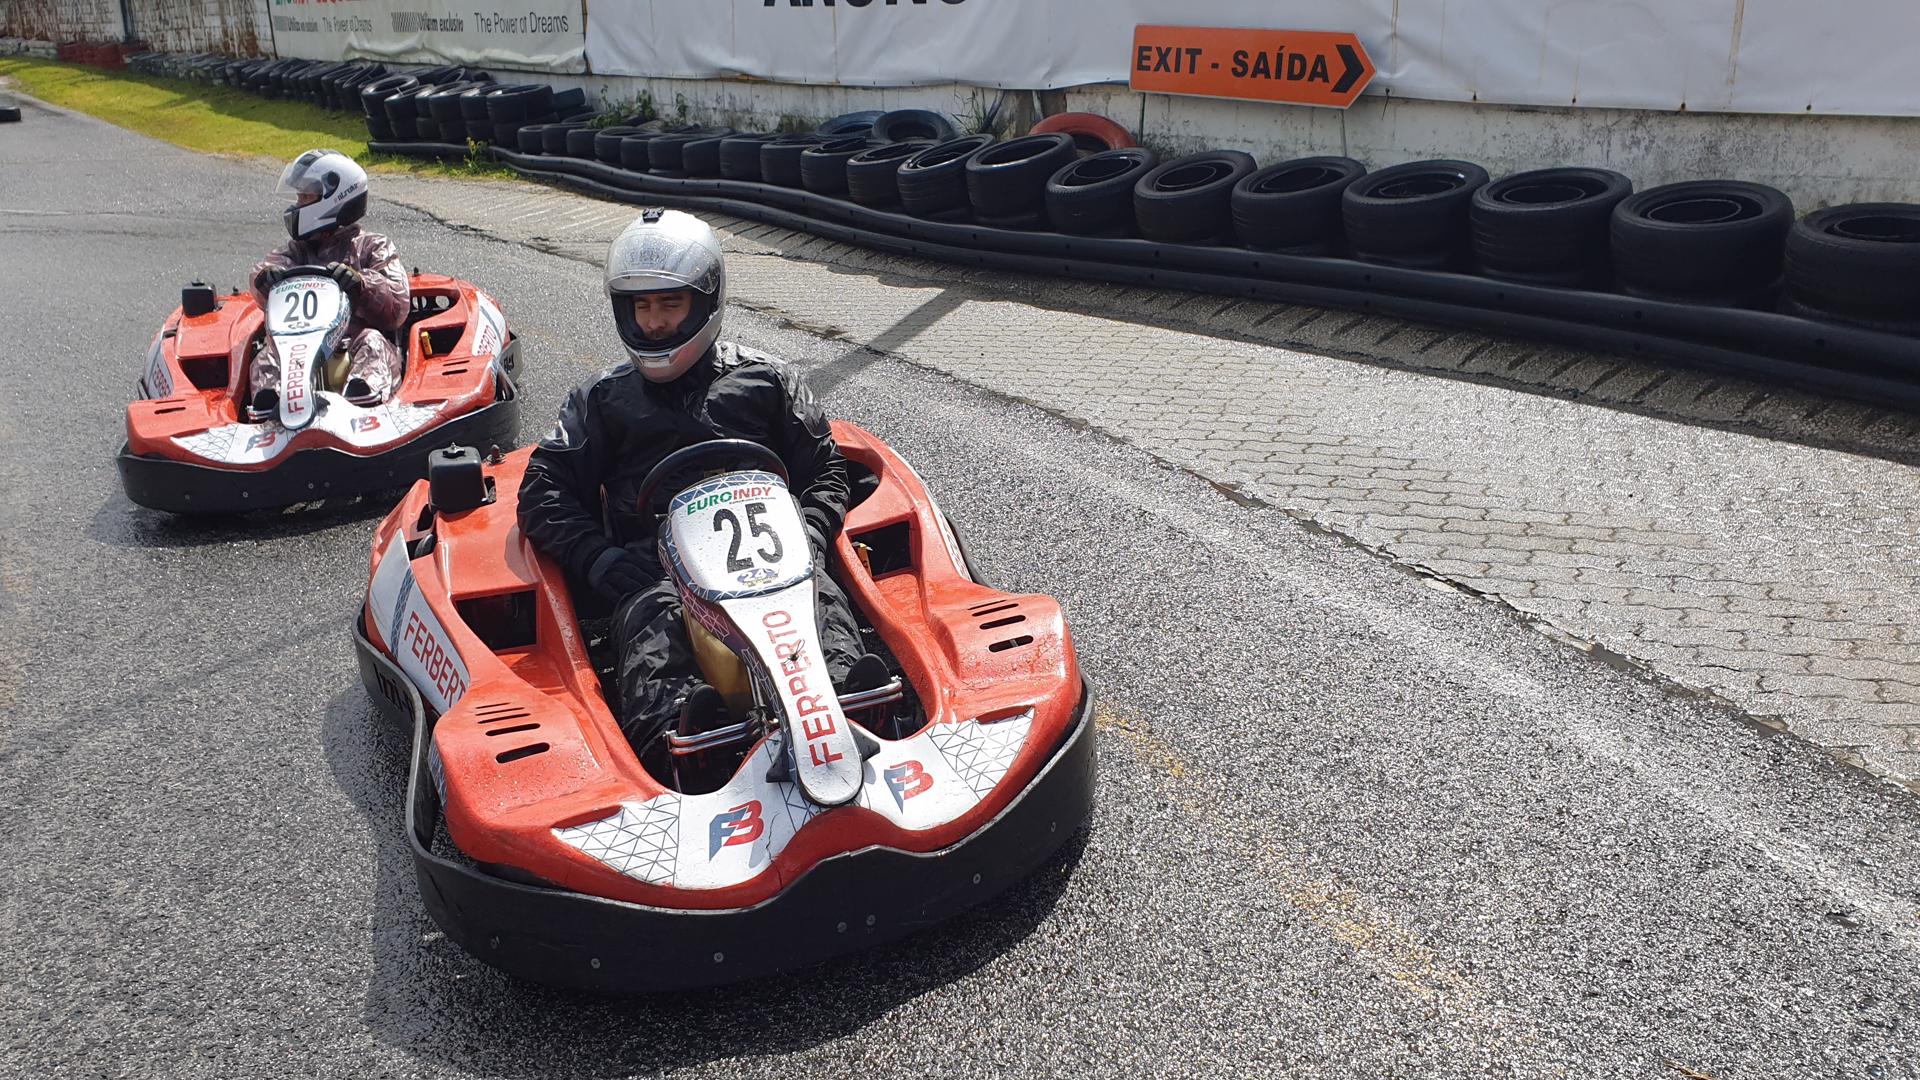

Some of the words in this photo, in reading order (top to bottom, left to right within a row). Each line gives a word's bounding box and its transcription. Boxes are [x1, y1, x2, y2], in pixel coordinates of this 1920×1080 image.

[474, 12, 492, 32] The
[494, 13, 518, 33] Power
[529, 11, 569, 33] Dreams
[1136, 45, 1202, 74] EXIT
[1231, 45, 1330, 84] SAÍDA
[283, 290, 318, 323] 20
[287, 343, 308, 414] FERBERTO
[687, 486, 772, 516] EUROINDY
[712, 502, 784, 574] 25
